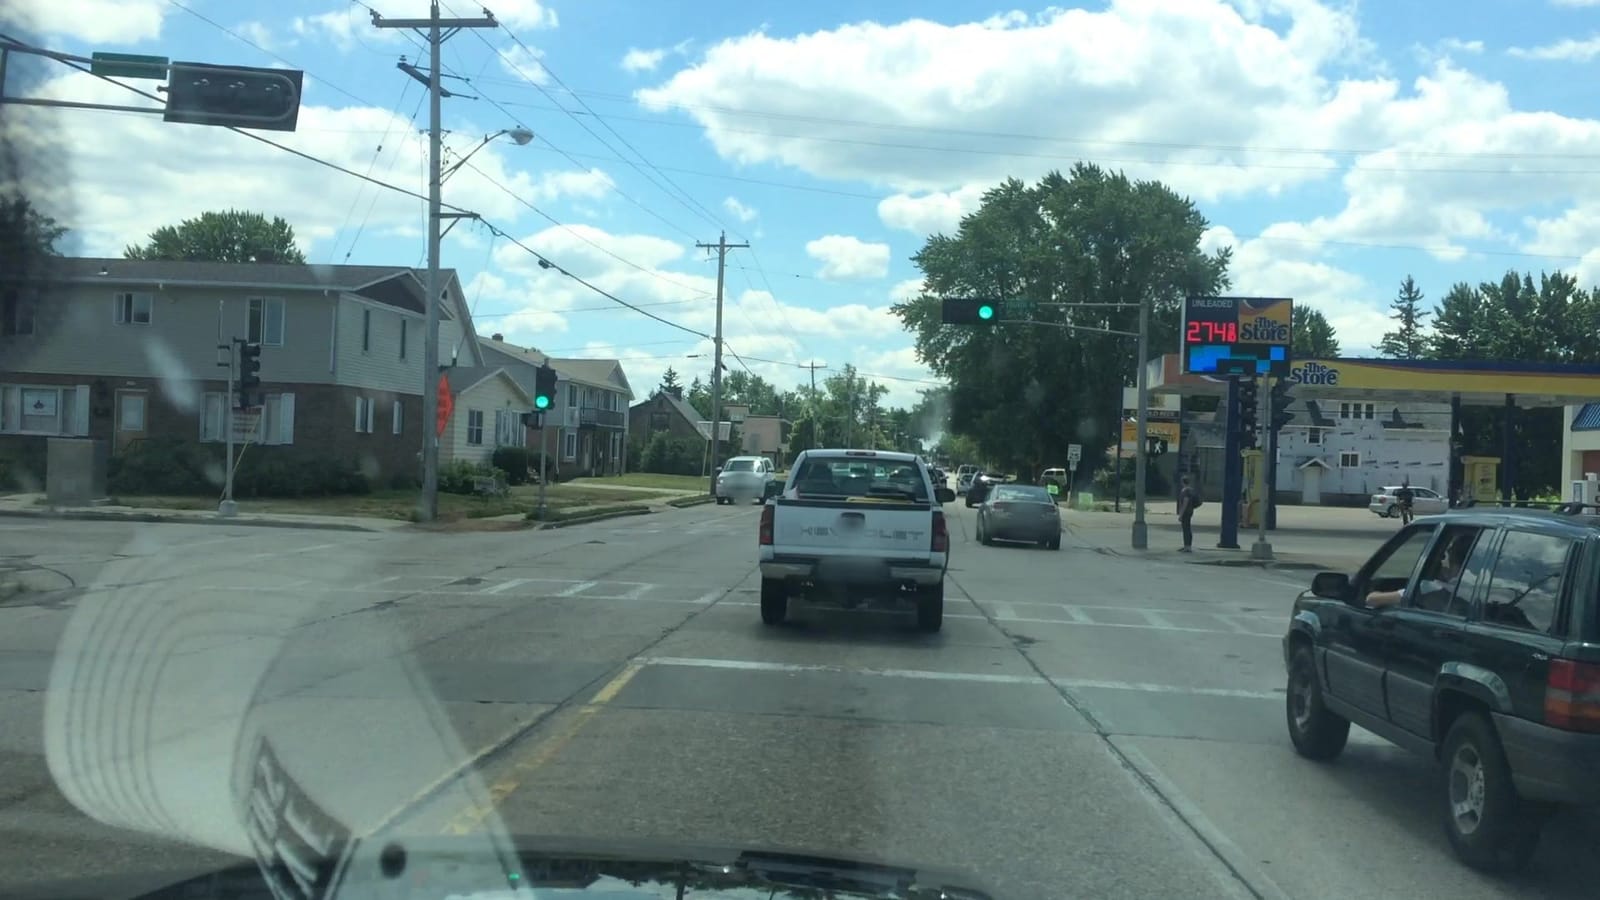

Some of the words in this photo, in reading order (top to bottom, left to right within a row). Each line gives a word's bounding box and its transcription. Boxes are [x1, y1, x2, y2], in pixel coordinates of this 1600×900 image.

[1191, 299, 1233, 308] UNLEADED
[1255, 317, 1277, 329] The
[1240, 324, 1288, 341] Store
[1304, 362, 1327, 373] The
[1291, 367, 1340, 385] Store
